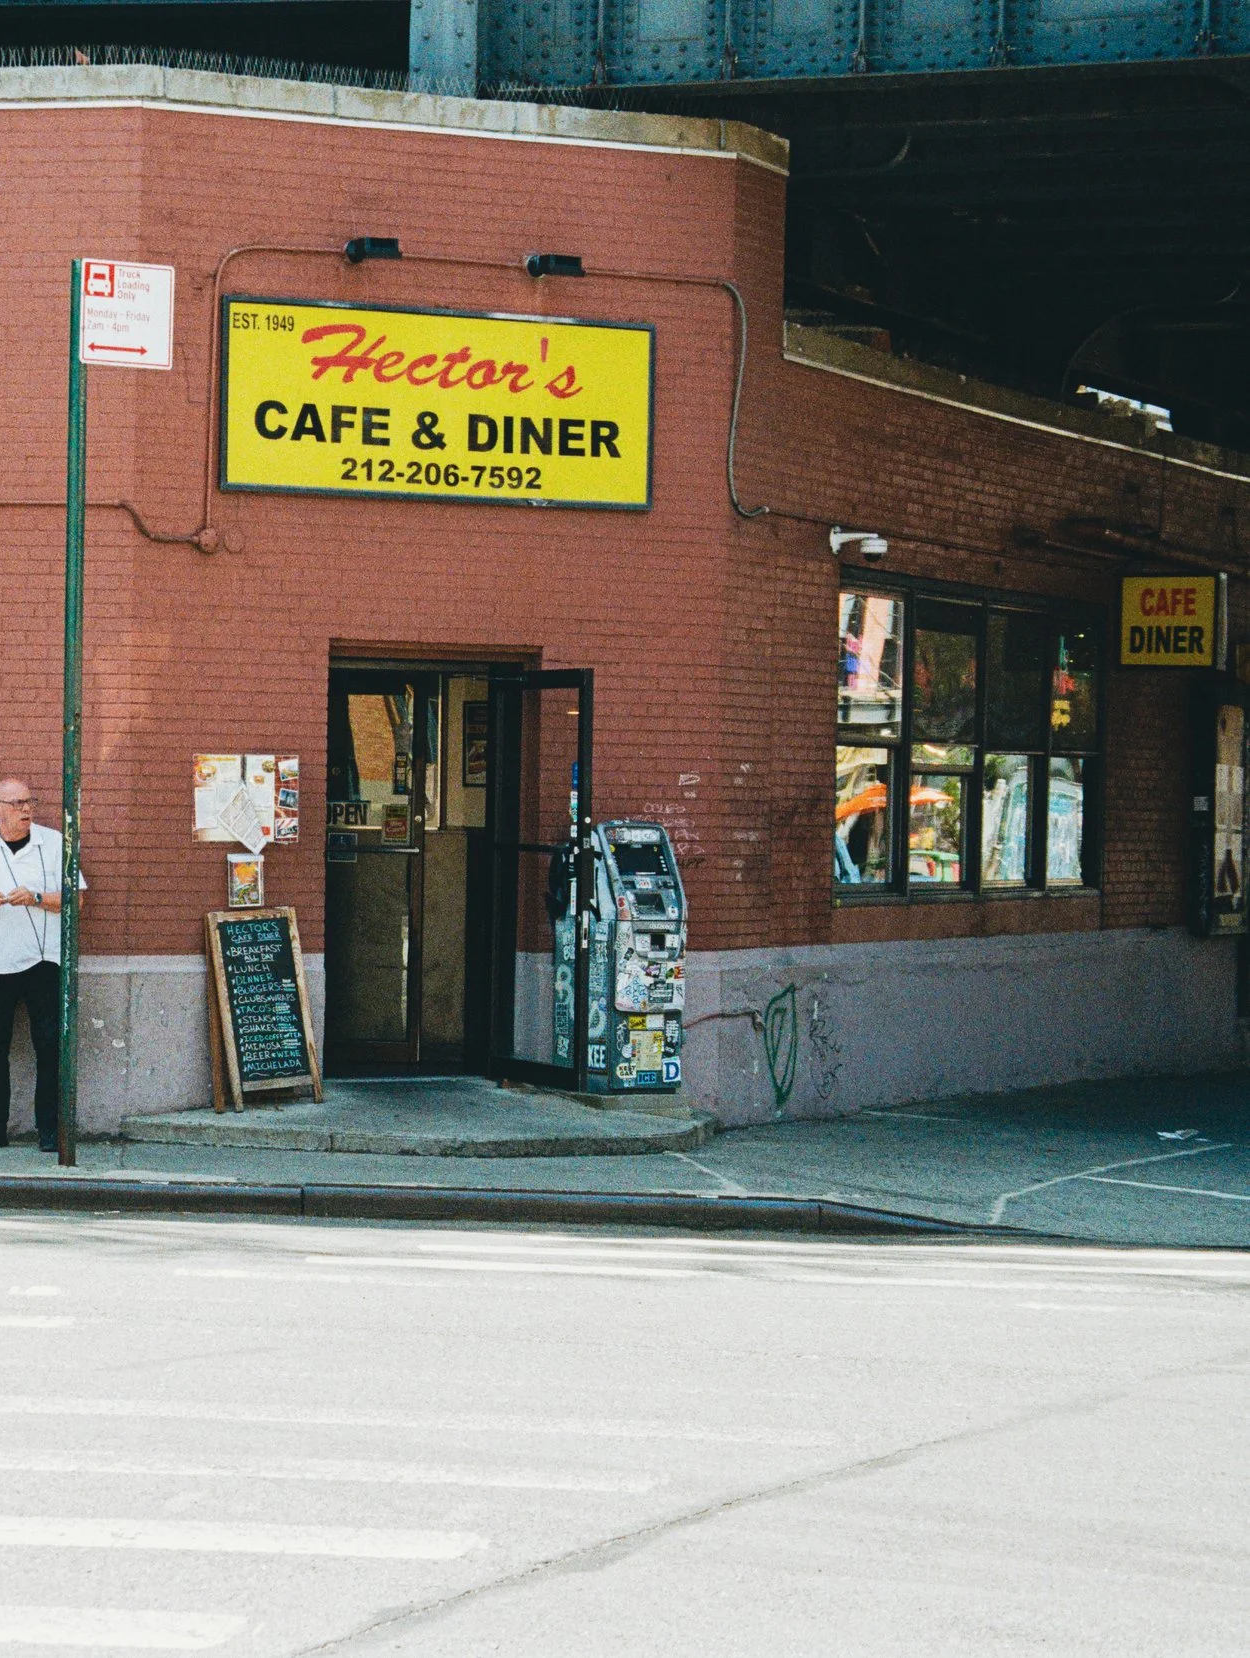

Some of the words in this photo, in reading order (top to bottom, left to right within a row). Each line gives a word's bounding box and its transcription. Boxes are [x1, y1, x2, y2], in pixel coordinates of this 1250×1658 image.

[118, 268, 141, 279] Truck
[117, 280, 150, 292] Loading
[117, 290, 137, 302] Only
[87, 307, 118, 320] Monday
[126, 310, 150, 323] Friday
[112, 321, 130, 333] 4pm
[232, 312, 260, 331] EST.
[264, 313, 295, 332] 1949
[301, 323, 584, 399] Hector's
[254, 400, 391, 447] CAFE
[411, 411, 446, 451] &
[468, 414, 621, 459] DINER
[340, 457, 542, 491] 212-206-7592
[1140, 587, 1197, 617] CAFE
[1129, 625, 1205, 655] DINER
[227, 921, 280, 936] HECTOR'S
[231, 934, 253, 942] CAFE
[230, 944, 282, 957] BREAKFAST
[244, 954, 259, 962] ALL
[234, 963, 270, 974] LUNCH
[235, 973, 274, 986] DINNER
[238, 994, 267, 1004] CLUBS
[242, 1014, 273, 1024] STEAKS
[245, 1050, 271, 1062] BEER
[246, 1059, 302, 1072] MICHELADA
[663, 1061, 680, 1081] D
